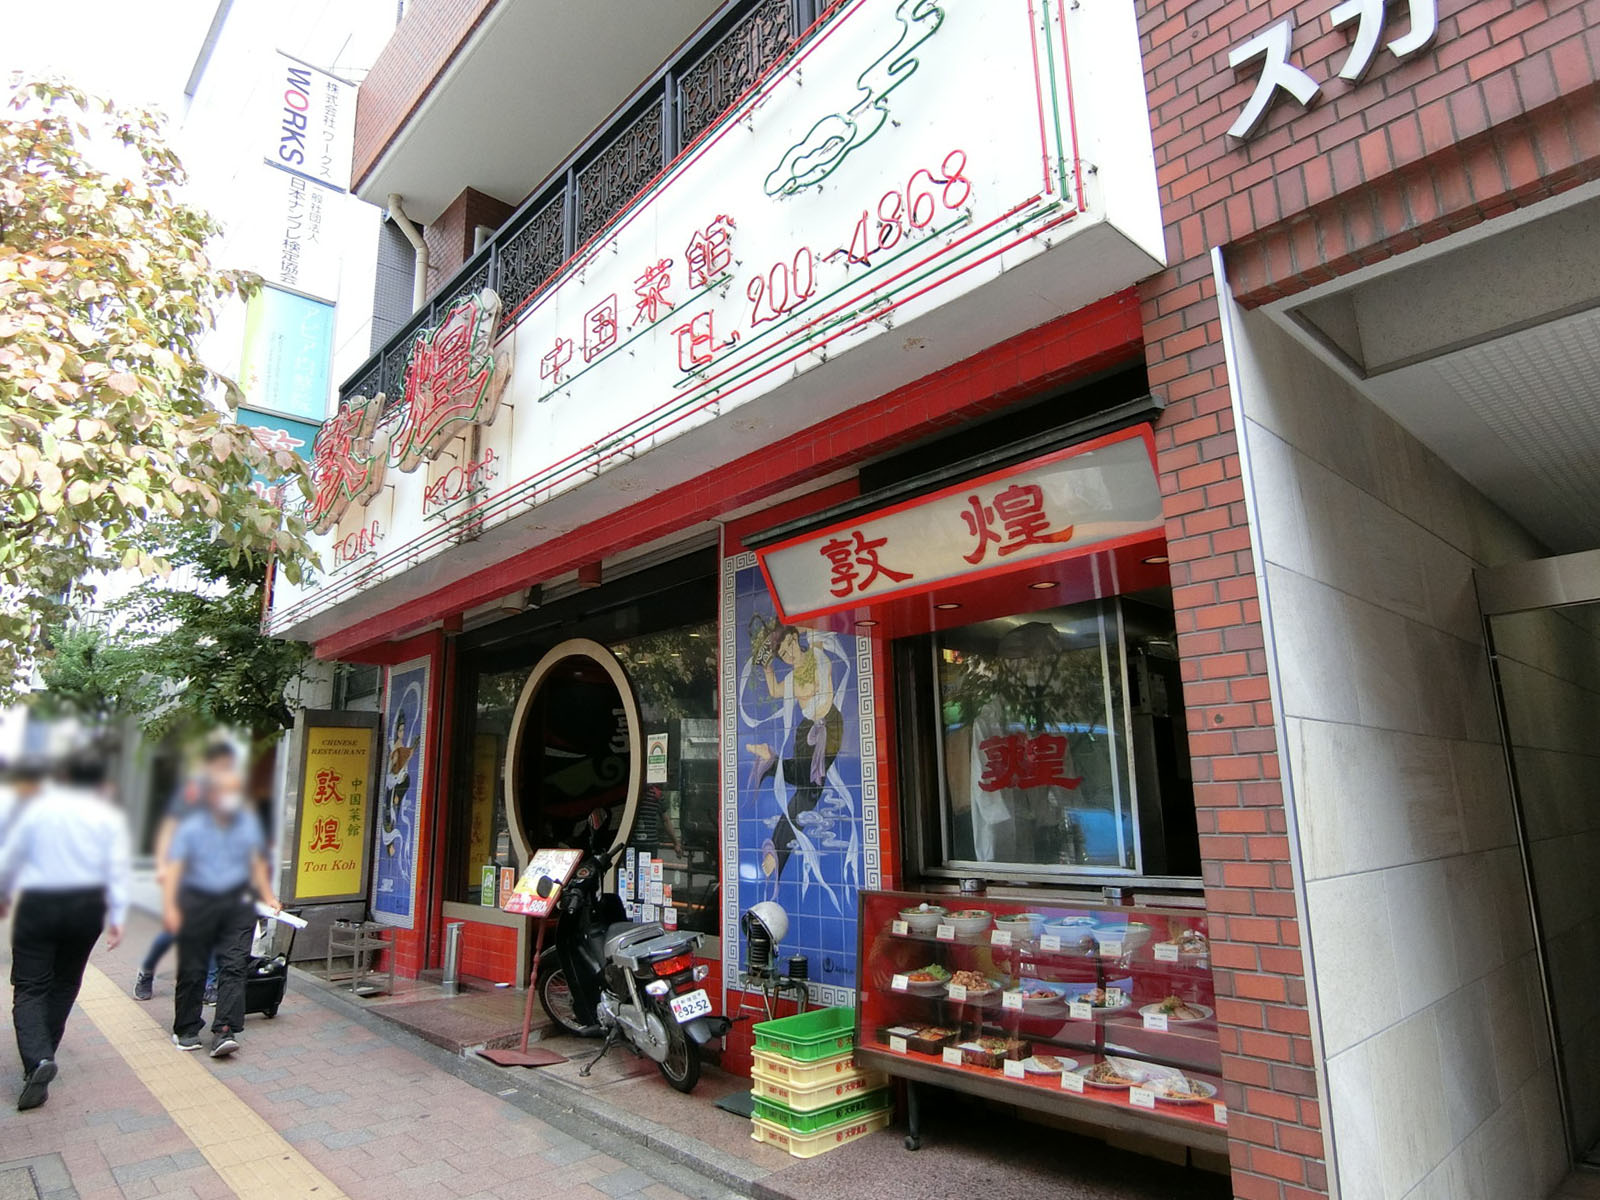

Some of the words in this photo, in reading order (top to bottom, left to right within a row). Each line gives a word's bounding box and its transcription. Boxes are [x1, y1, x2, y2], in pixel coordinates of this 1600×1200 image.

[279, 67, 312, 165] WORKS
[332, 520, 380, 568] TON
[819, 484, 1074, 598] 敦煌
[311, 748, 367, 756] RESTAURANT
[321, 739, 359, 747] CHINESE
[310, 768, 345, 852] 敦煌
[304, 861, 328, 872] Ton
[331, 859, 357, 871] Koh
